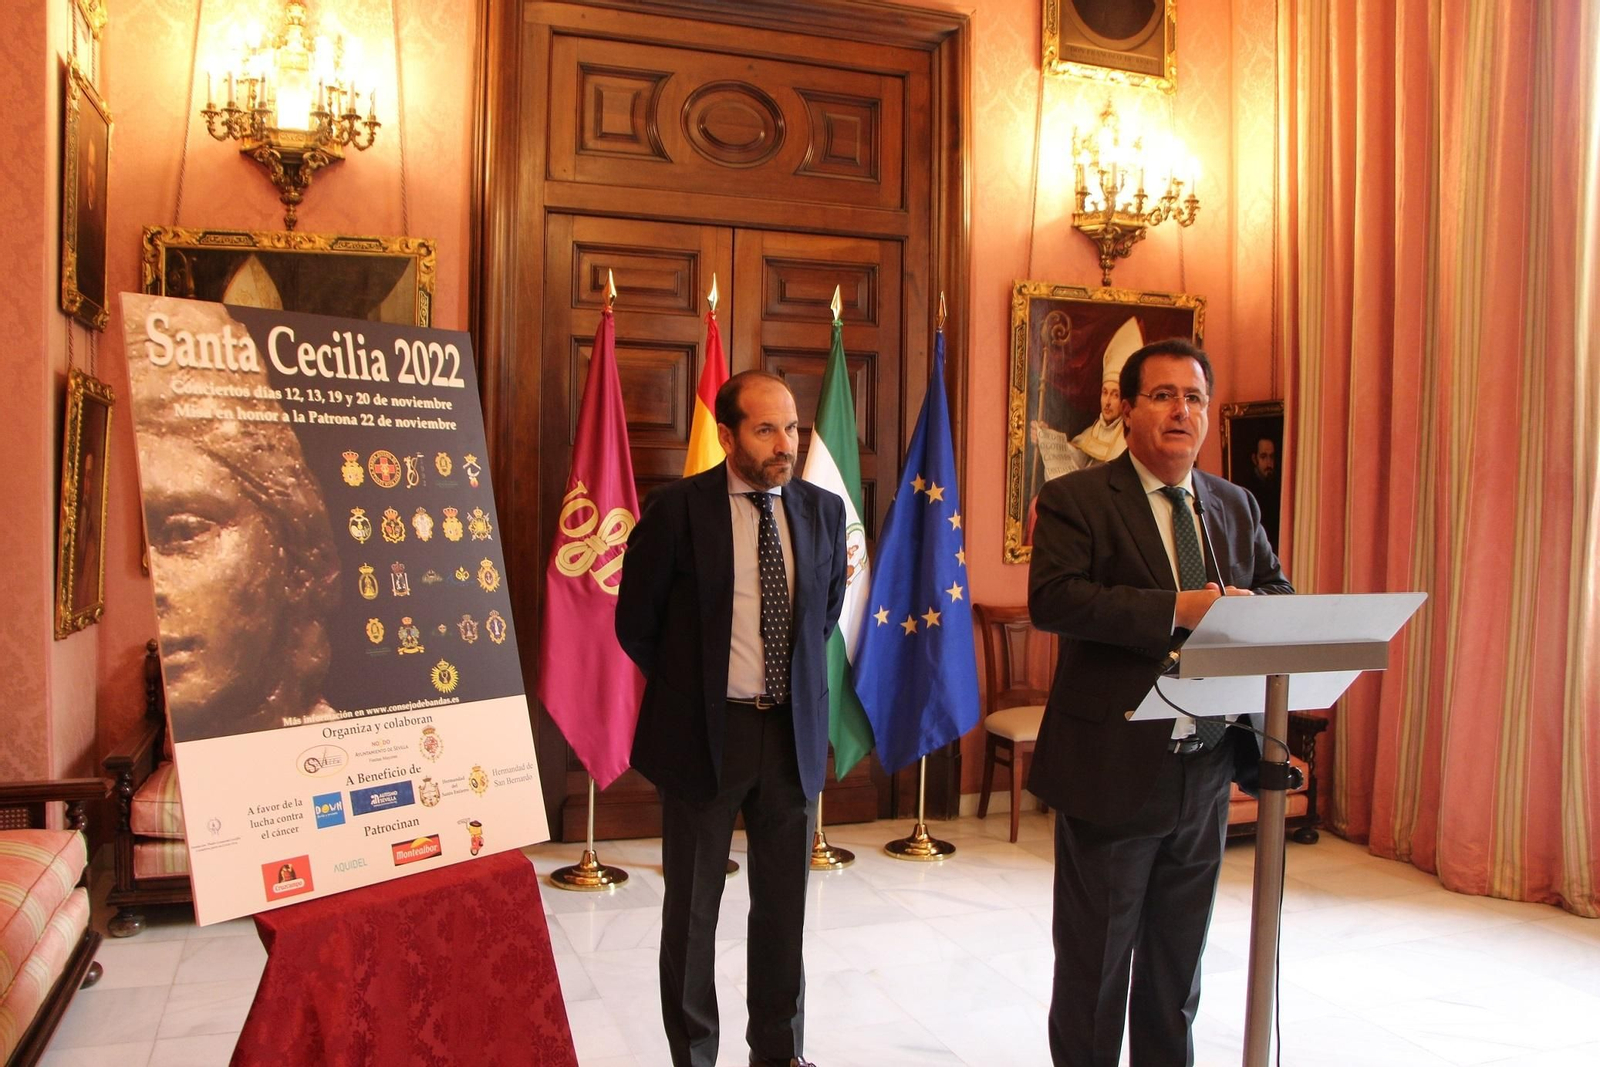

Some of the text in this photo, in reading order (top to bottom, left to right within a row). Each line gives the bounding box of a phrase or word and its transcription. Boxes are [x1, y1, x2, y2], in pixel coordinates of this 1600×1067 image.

[145, 312, 465, 388] Santa Cecilia 2022
[172, 379, 453, 410] Conciertos días 12, 13, 19 y 20 de noviembre
[173, 403, 457, 430] Misa en honor a la Patrona 22 de noviembre
[282, 696, 460, 726] Más información en www.consejodebandas.es
[322, 715, 433, 740] Organiza y colaboran
[346, 764, 422, 786] A Beneficio de
[492, 762, 534, 777] Hermandad de
[494, 774, 533, 788] San Bernardo
[247, 798, 303, 816] A favor de la
[250, 815, 275, 829] lucha
[276, 812, 304, 824] contra
[364, 818, 420, 837] Patrocinan
[261, 825, 300, 840] el cáncer
[396, 844, 438, 860] Montealbor
[333, 857, 368, 873] AQUIDEL
